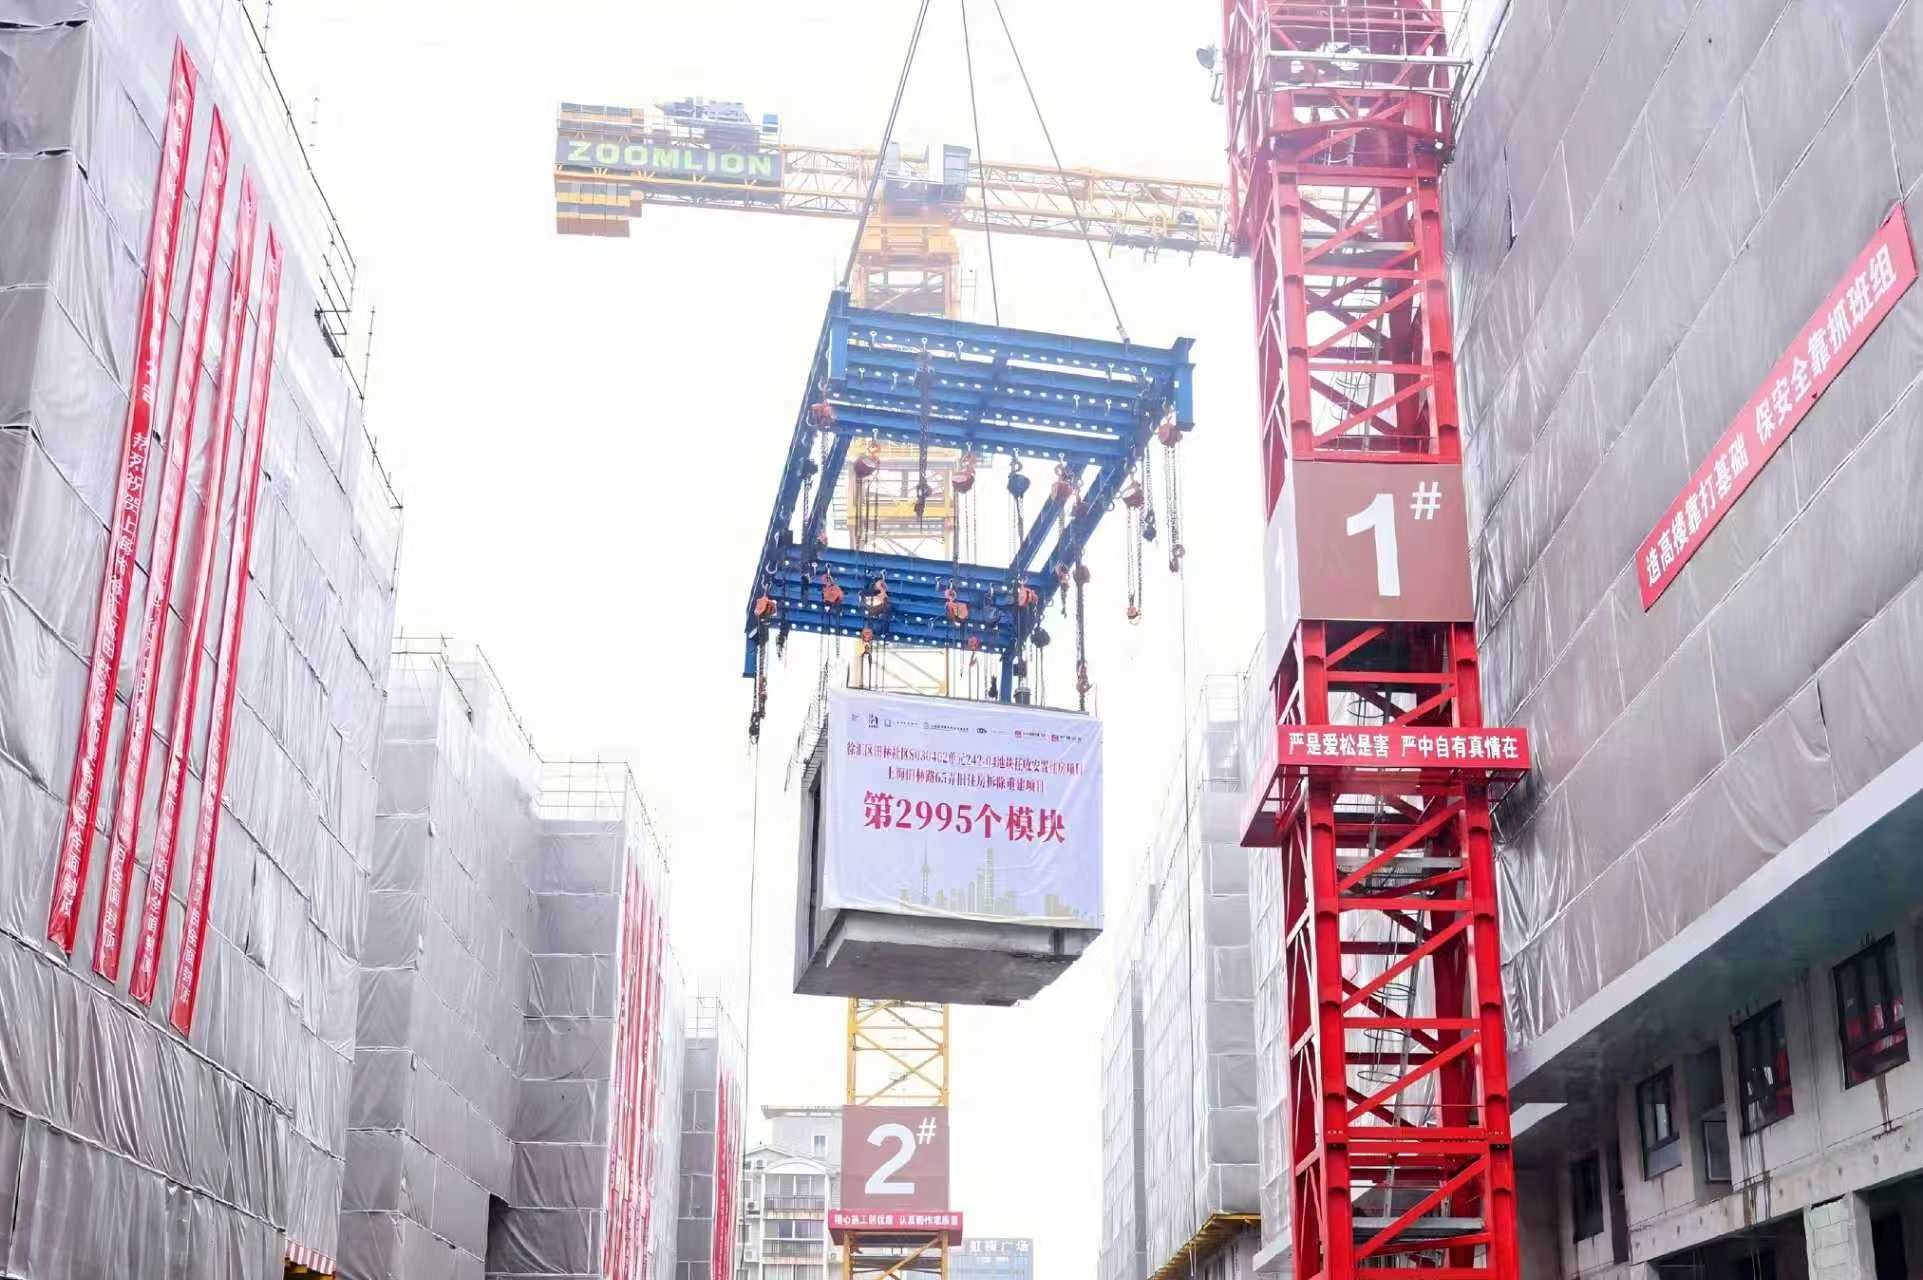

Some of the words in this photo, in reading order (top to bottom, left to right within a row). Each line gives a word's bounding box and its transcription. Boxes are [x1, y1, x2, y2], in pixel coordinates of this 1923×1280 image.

[567, 140, 772, 177] ZOOMLION
[1644, 431, 1750, 588] 造高楼靠打基础
[1754, 242, 1897, 447] 保安全靠抓班组
[1288, 732, 1390, 758] 严是爱松是害
[1400, 734, 1520, 760] 严中自有真情在
[863, 790, 1066, 844] 第2995个模块
[864, 1116, 937, 1195] 2#
